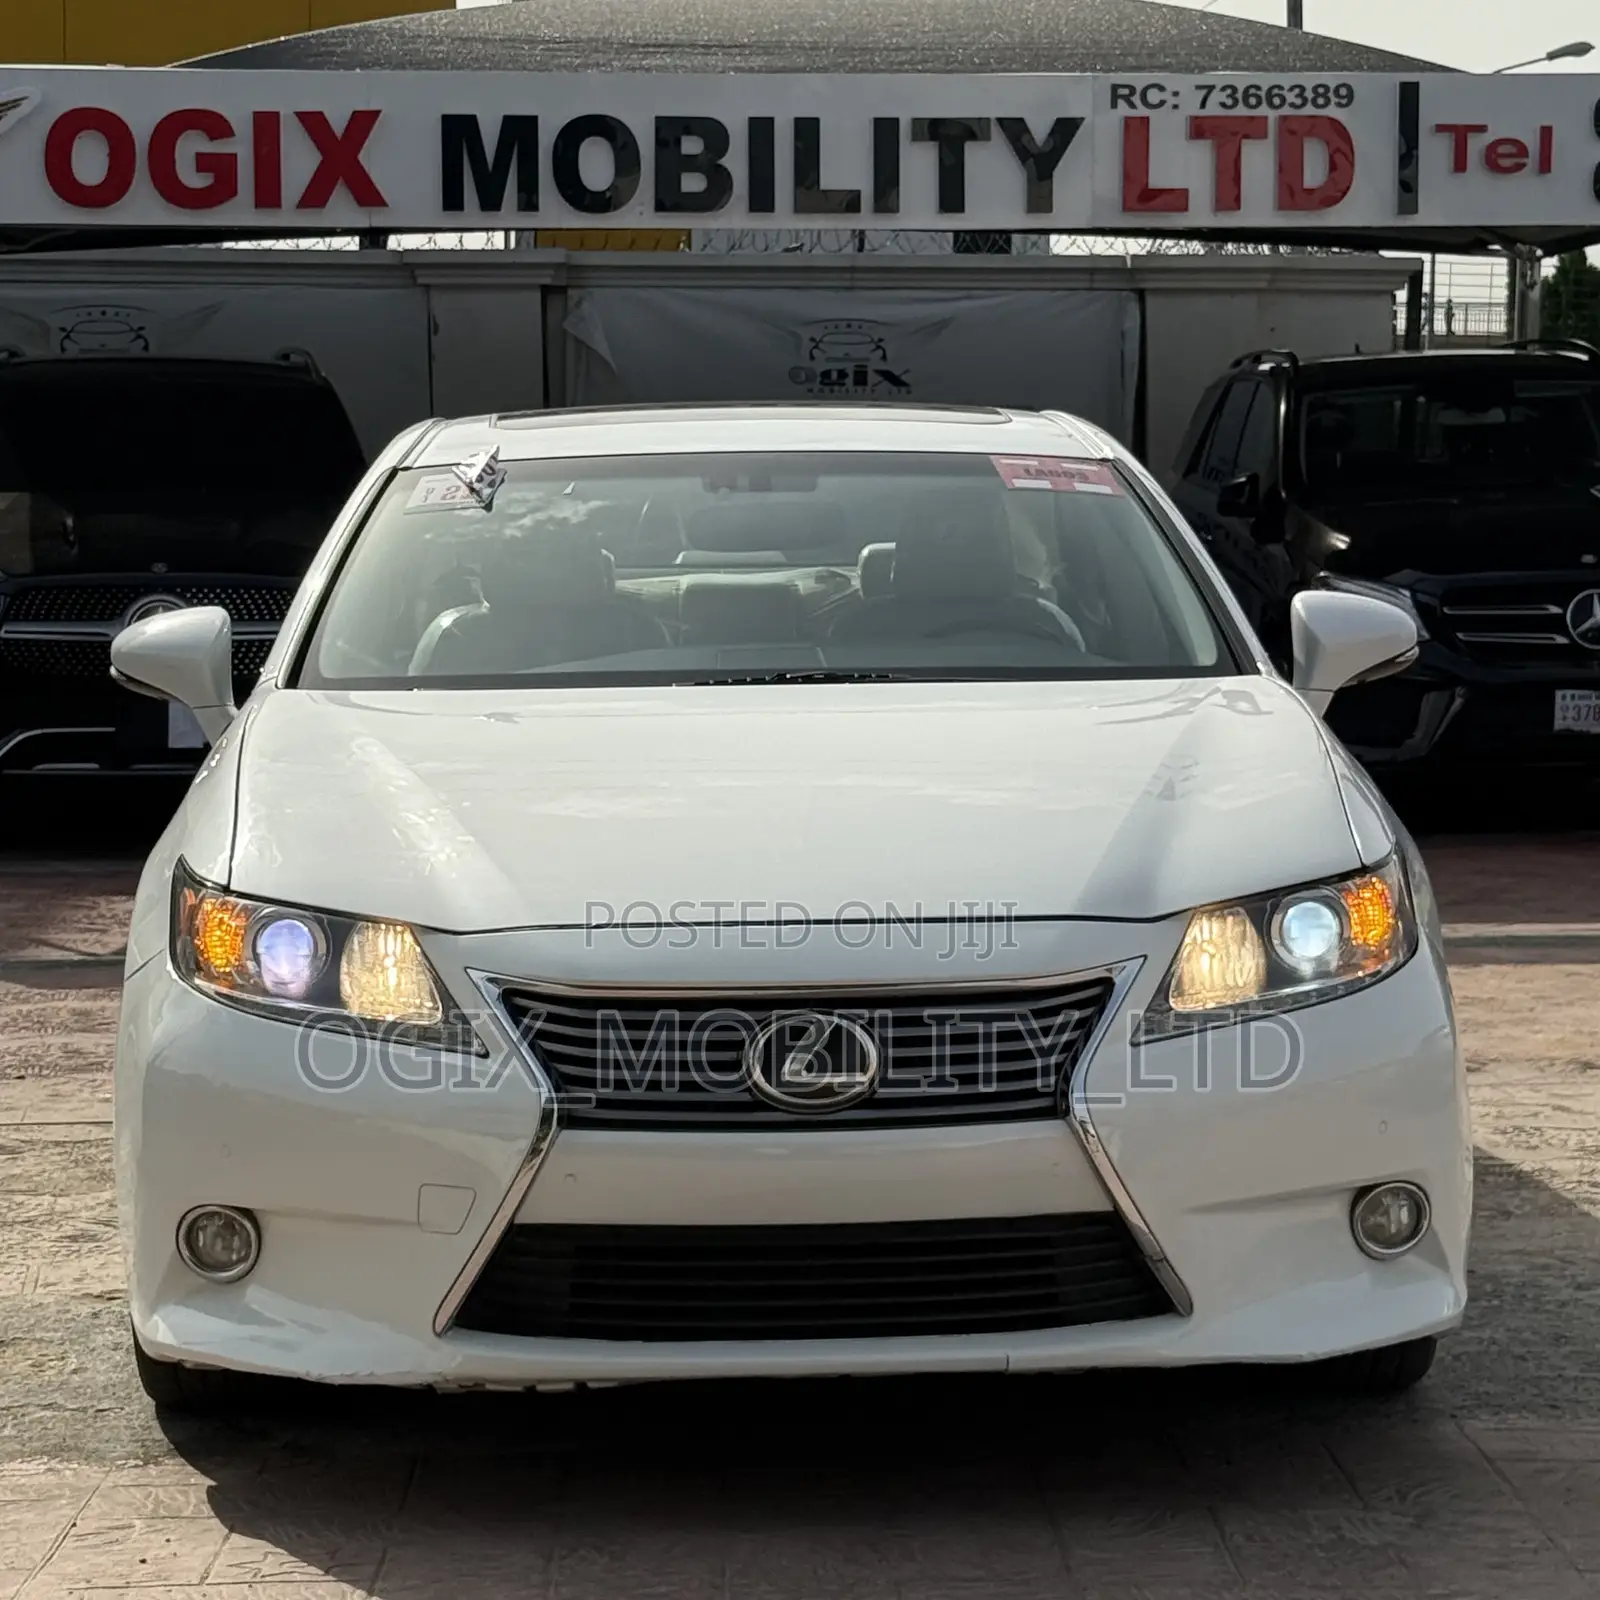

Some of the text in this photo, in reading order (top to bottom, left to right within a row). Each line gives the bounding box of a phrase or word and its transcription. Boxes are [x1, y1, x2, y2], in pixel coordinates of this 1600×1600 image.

[1110, 83, 1355, 111] RC: 7366389
[43, 106, 389, 211] OGIX
[440, 114, 1086, 214] MOBILITY
[1121, 115, 1356, 213] LTD
[1434, 123, 1553, 175] Tel
